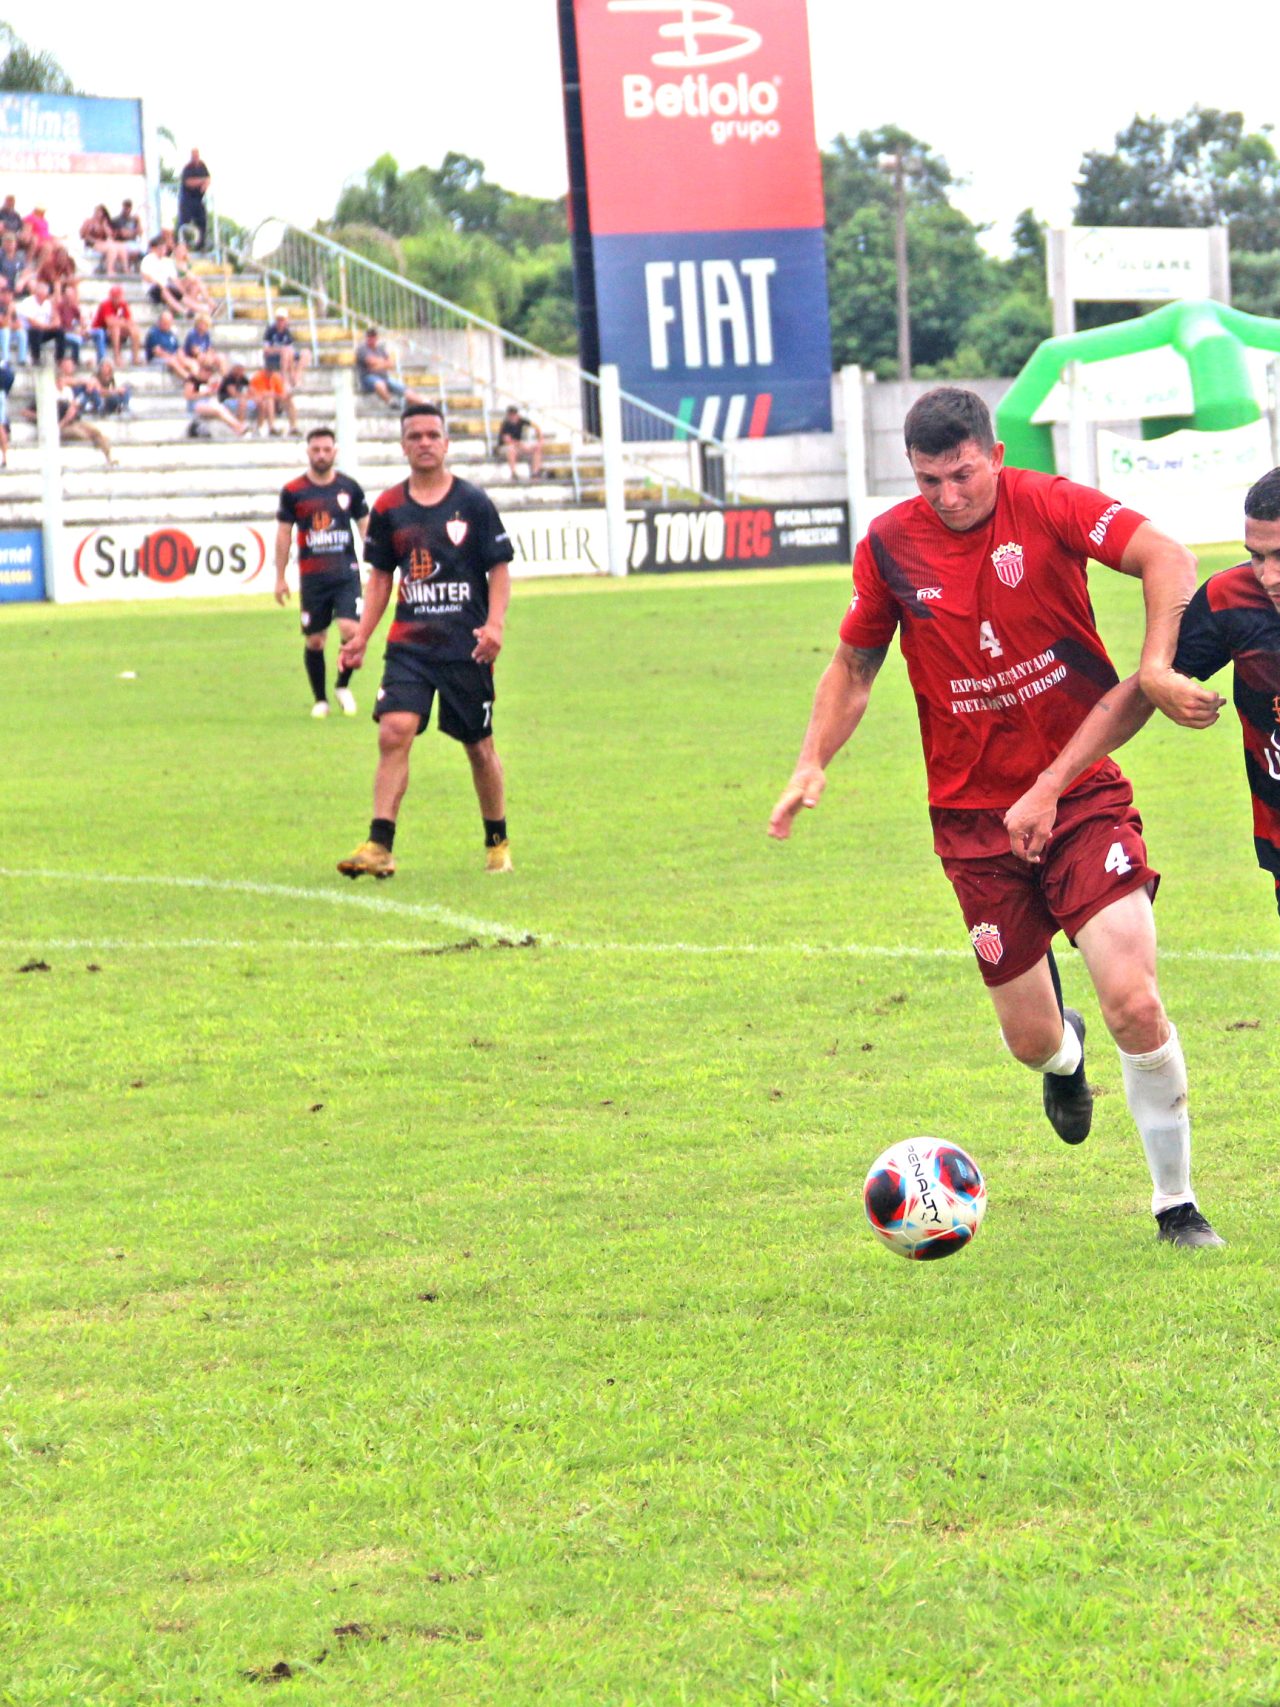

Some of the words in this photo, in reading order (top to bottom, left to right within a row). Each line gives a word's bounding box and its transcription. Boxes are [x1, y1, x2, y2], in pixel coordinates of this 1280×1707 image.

[622, 72, 779, 119] Betiolo
[710, 119, 781, 145] grupo
[644, 257, 777, 370] FIAT
[653, 510, 772, 564] TOYOTEC
[979, 620, 1004, 659] 4
[1104, 841, 1132, 876] 4
